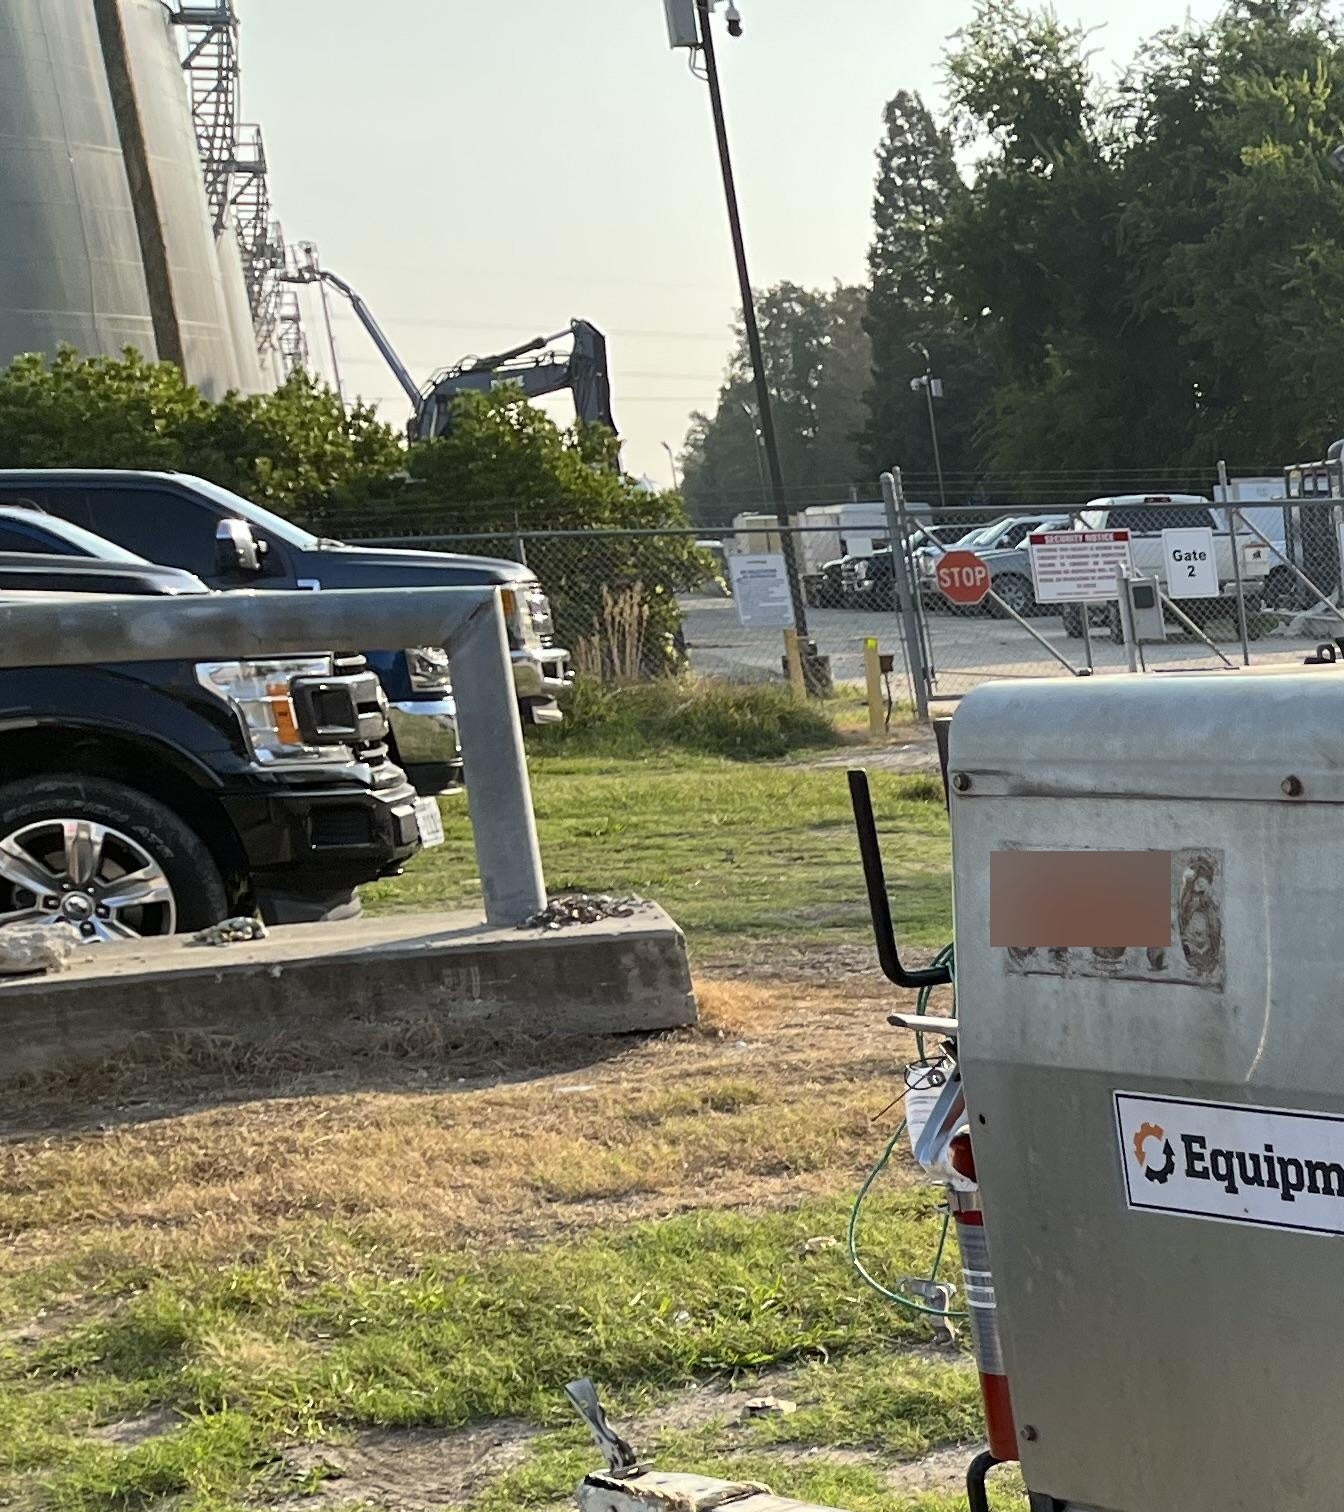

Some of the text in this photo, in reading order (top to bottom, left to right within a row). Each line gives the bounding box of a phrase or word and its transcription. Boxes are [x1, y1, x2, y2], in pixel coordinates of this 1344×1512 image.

[1172, 550, 1207, 562] Gate
[939, 566, 986, 588] STOP
[1187, 566, 1196, 577] 2
